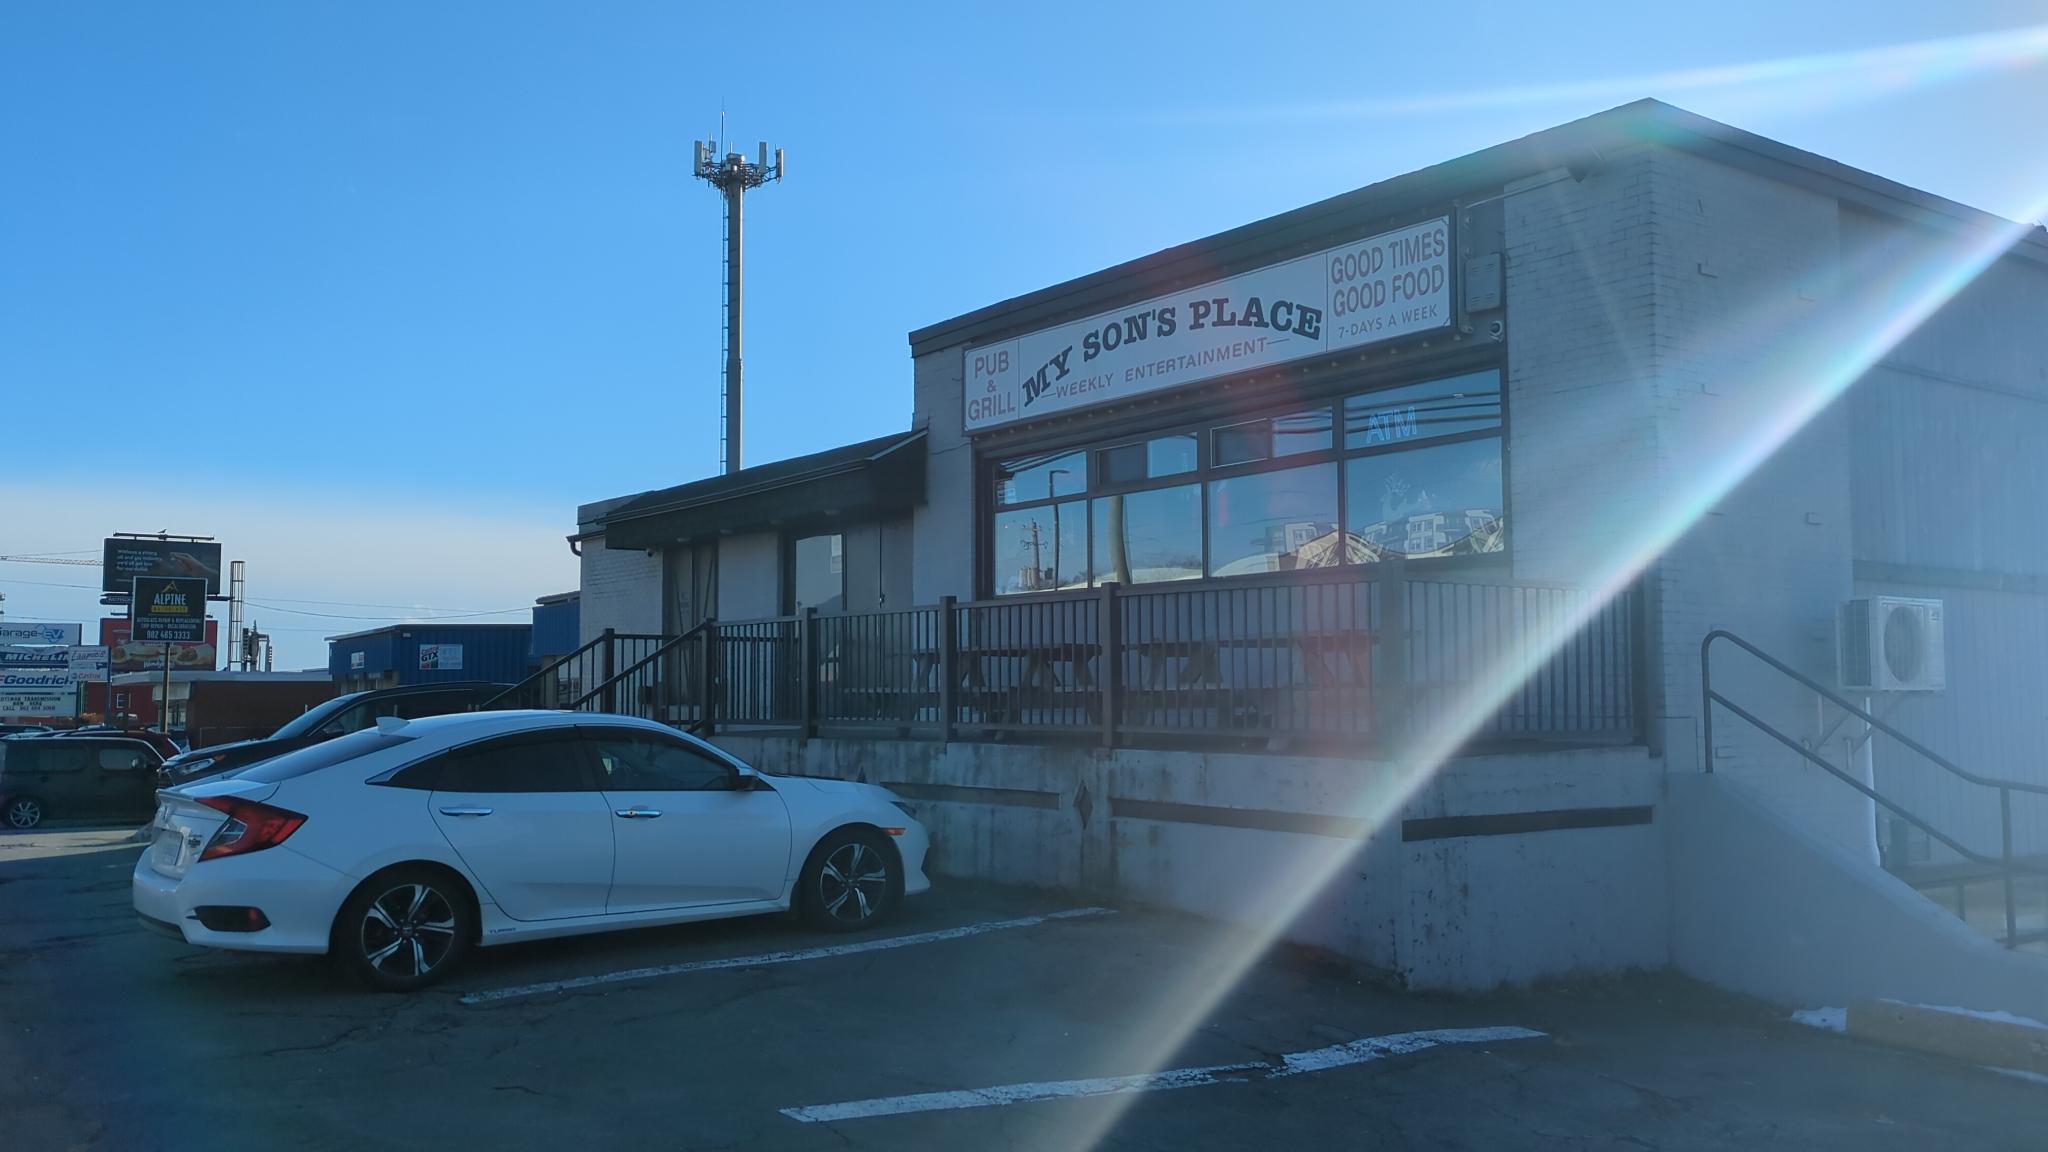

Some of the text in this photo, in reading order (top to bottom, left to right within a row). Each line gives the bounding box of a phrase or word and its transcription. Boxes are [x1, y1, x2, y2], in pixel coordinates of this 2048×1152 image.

[1331, 228, 1446, 285] GOOD TIMES
[1333, 264, 1445, 318] GOOD FOOD
[1338, 303, 1438, 339] 7-DAYS A WEEK
[974, 350, 1009, 379] PUB
[1022, 297, 1323, 408] MY SON'S PLACE
[1055, 337, 1268, 399] WEEKLY ENTERTAINMENT
[986, 379, 997, 392] &
[967, 392, 1016, 422] GRILL
[1366, 406, 1418, 445] ATM
[153, 592, 187, 605] ALPINE
[160, 630, 173, 640] 465
[173, 631, 190, 640] 3333
[421, 651, 438, 662] GTX
